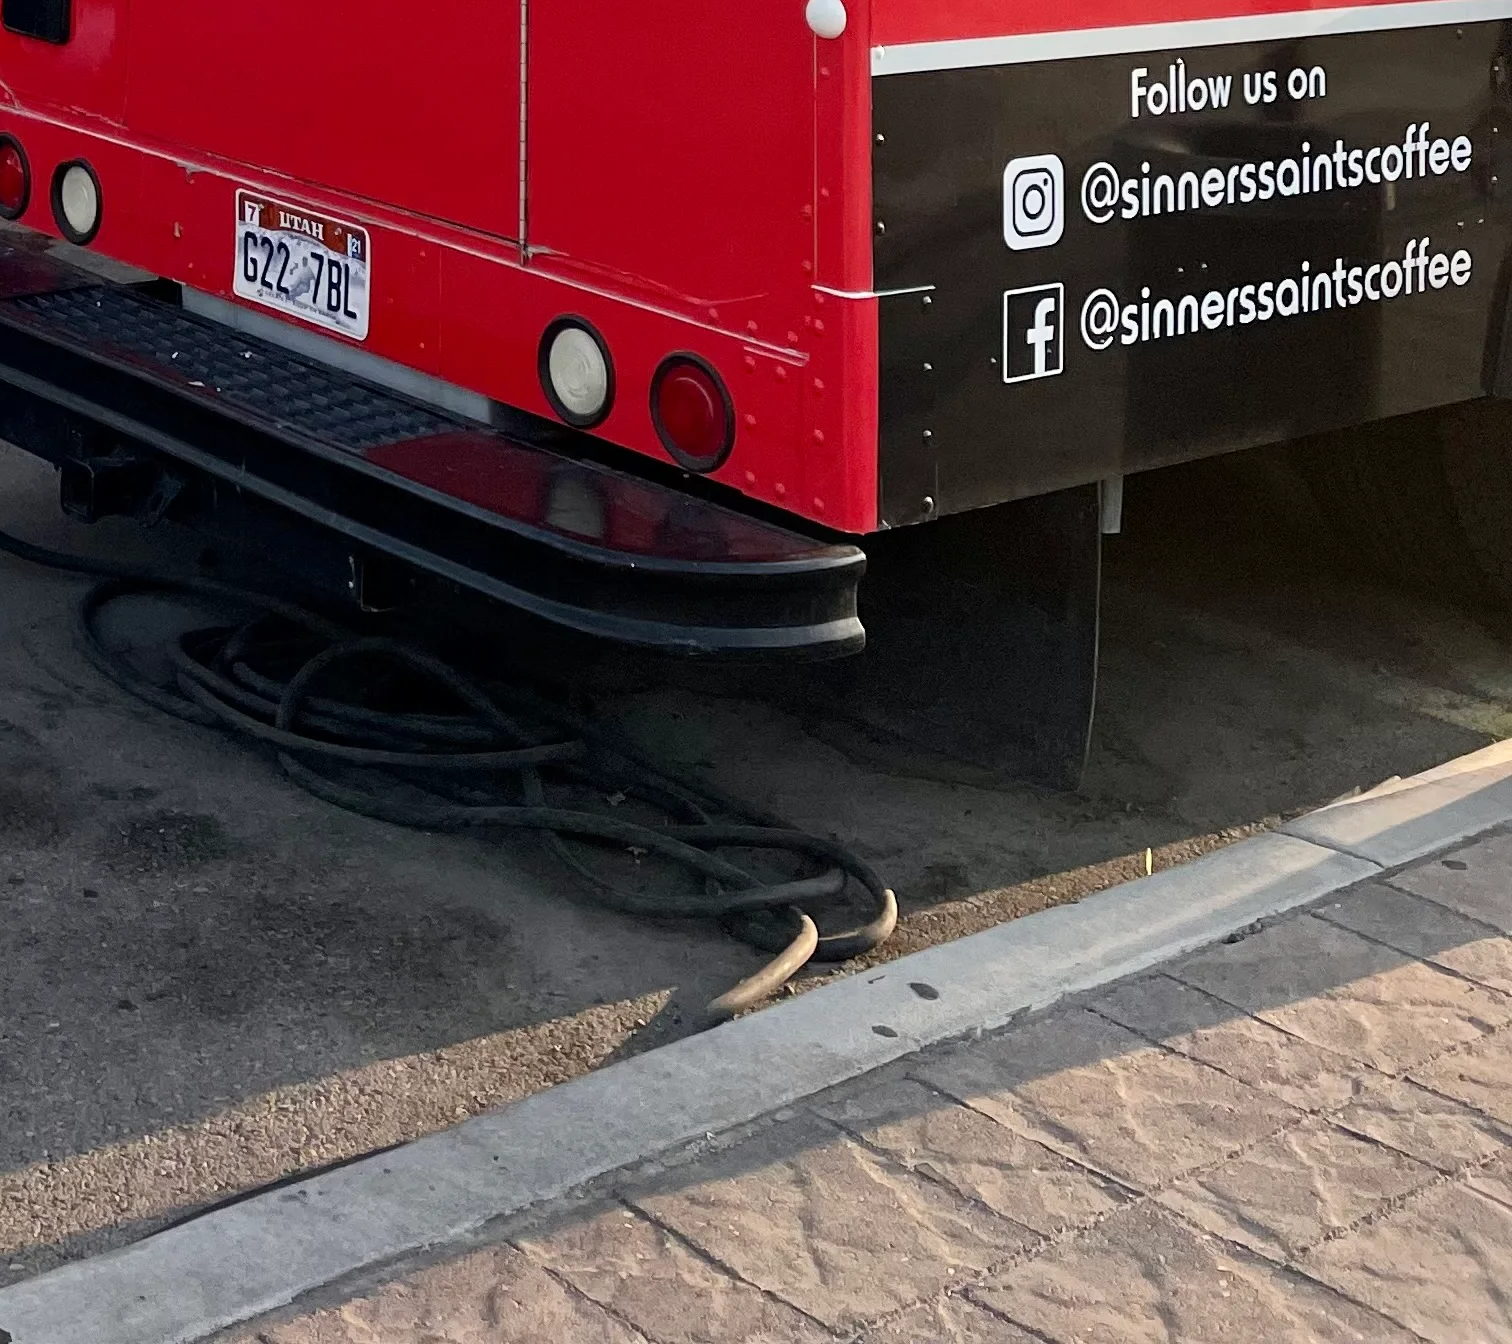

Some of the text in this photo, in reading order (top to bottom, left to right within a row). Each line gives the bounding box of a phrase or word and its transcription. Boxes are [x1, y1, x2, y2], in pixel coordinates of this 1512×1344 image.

[1131, 62, 1326, 118] Follow us on
[1081, 122, 1472, 223] @sinnerssaintscoffee
[248, 206, 257, 222] 7
[279, 211, 324, 240] UTAH
[1080, 236, 1472, 350] @sinnerssaintscoffee
